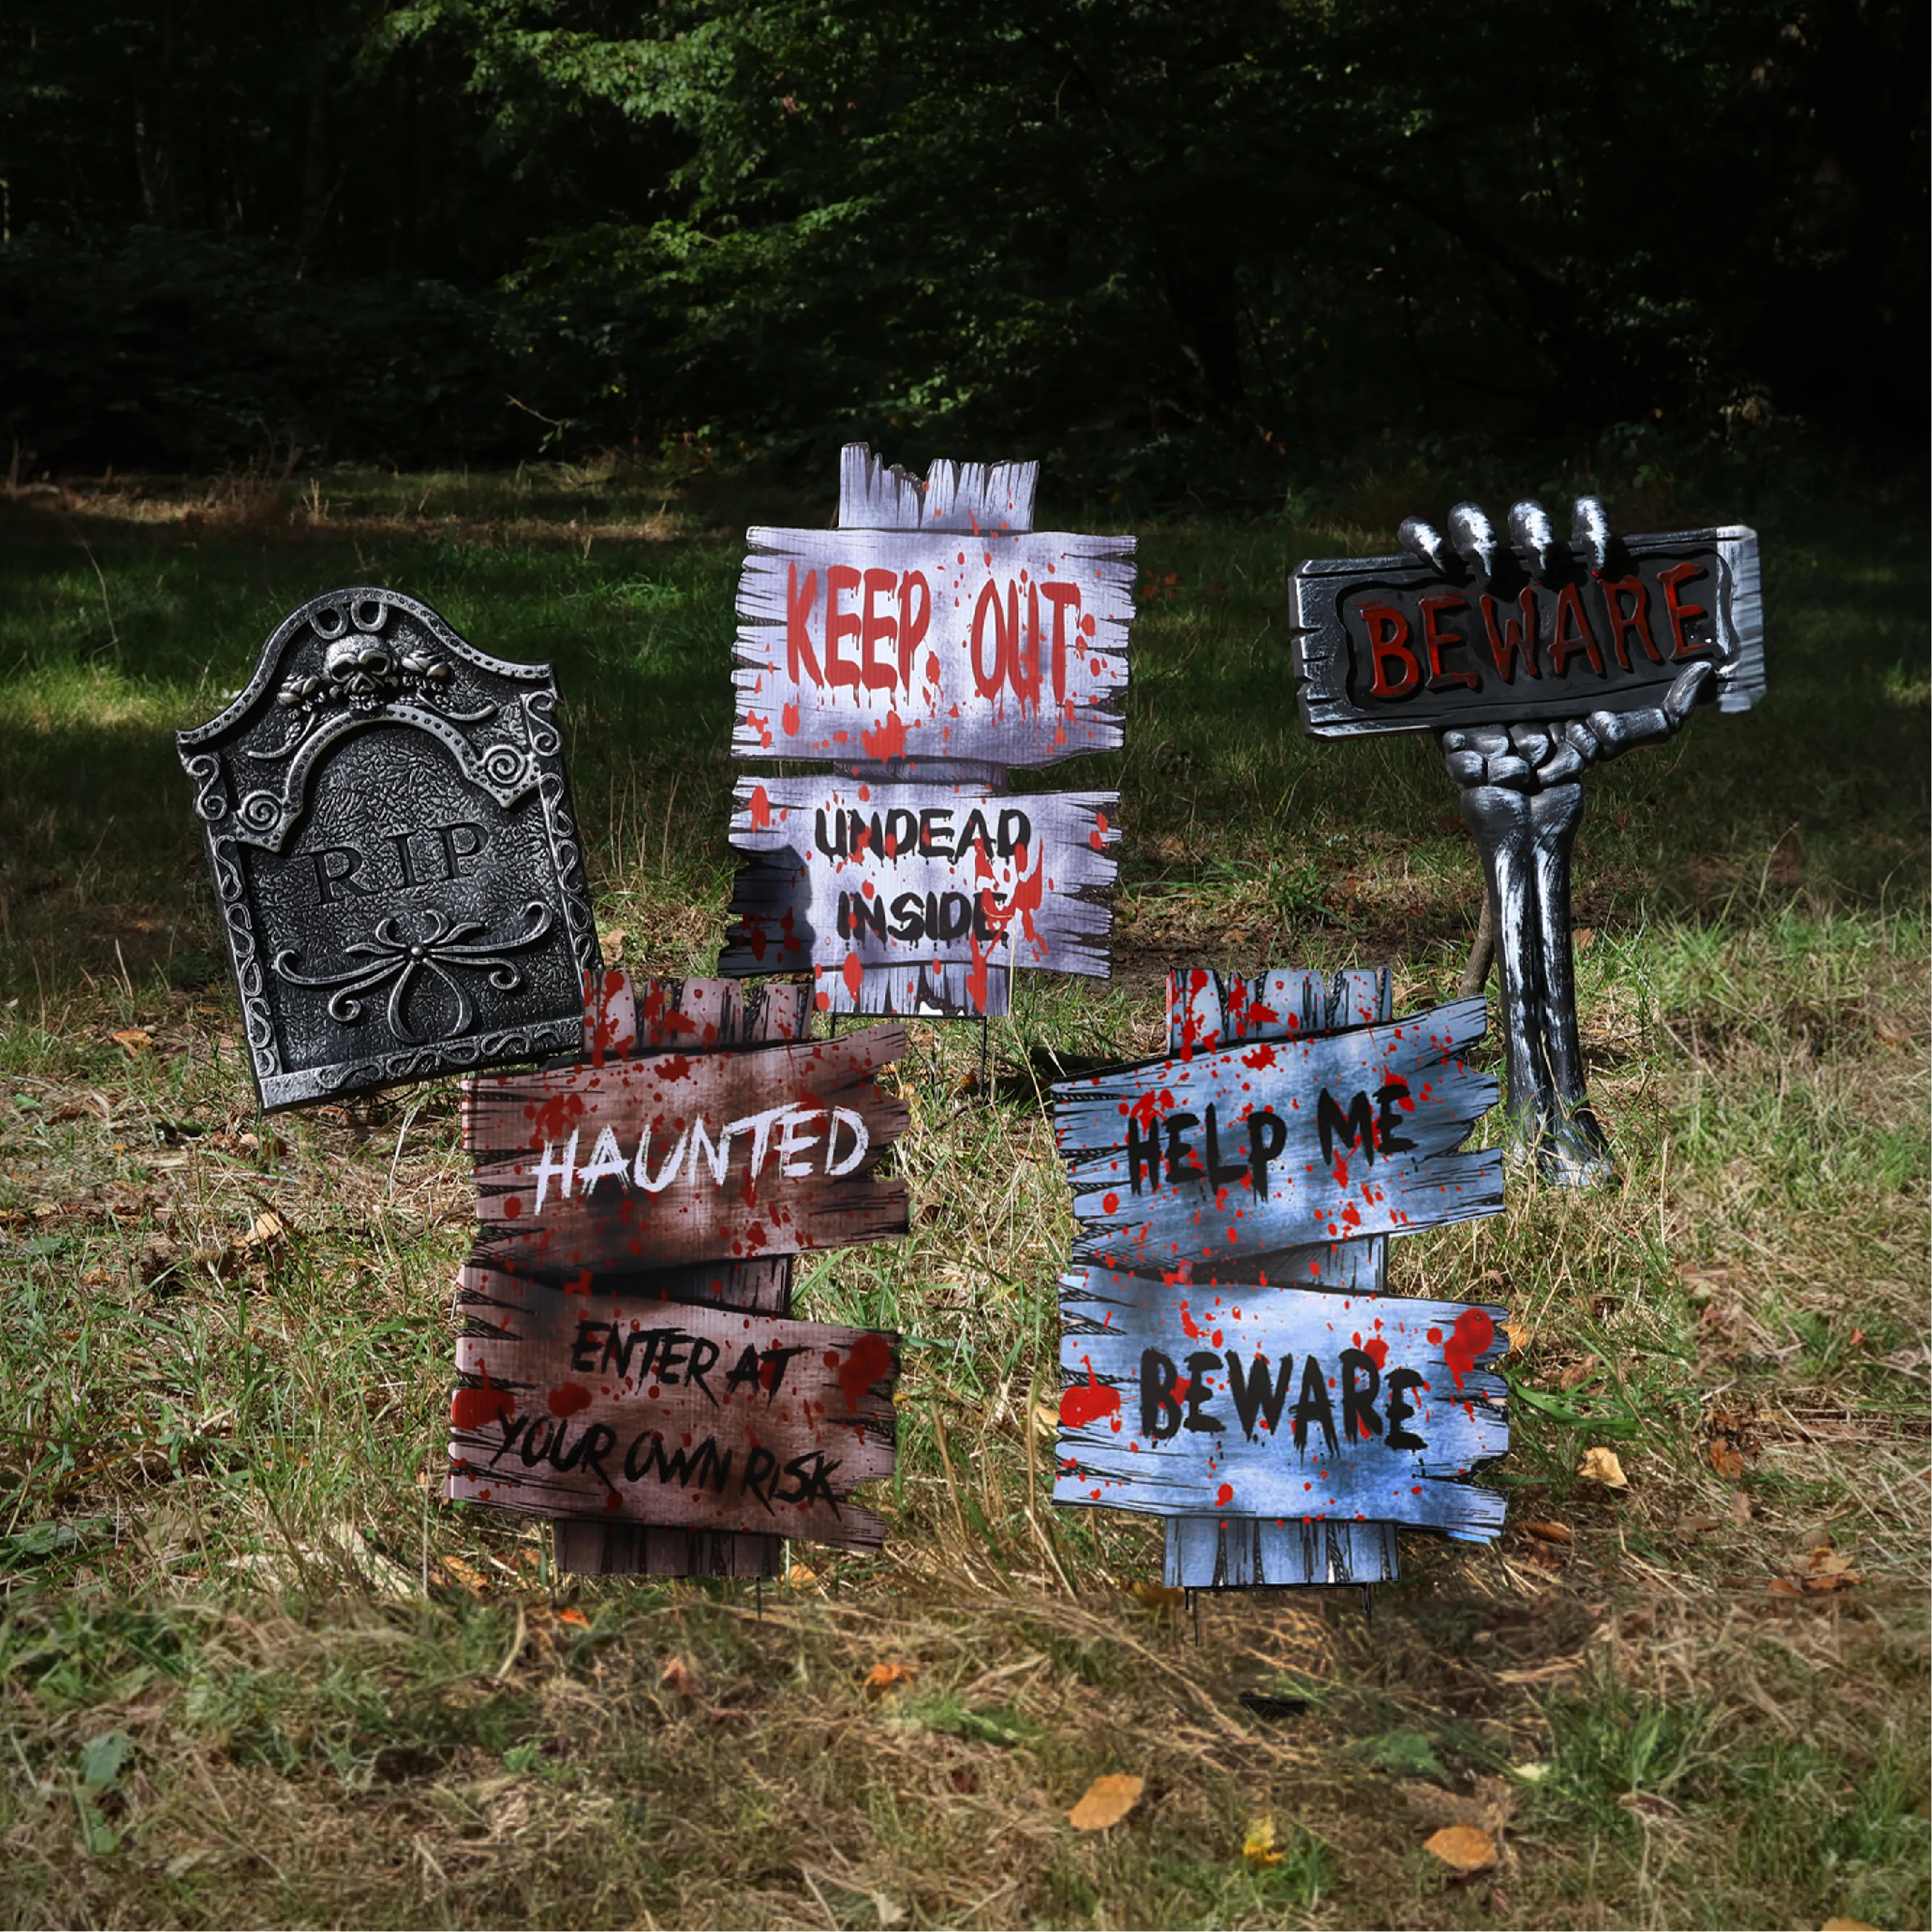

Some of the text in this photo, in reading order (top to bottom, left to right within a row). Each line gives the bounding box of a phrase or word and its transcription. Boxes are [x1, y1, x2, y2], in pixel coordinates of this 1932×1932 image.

[785, 561, 1081, 710] KEEP OUT
[1357, 562, 1713, 696] BEWARE
[301, 822, 491, 907] RIP
[814, 807, 1033, 863] UNDEAD
[837, 890, 1009, 945] INSIDE
[531, 1102, 870, 1216] HAUNTED
[1128, 1083, 1418, 1202] HELP ME
[570, 1319, 815, 1410] ENTER AT
[1139, 1347, 1428, 1464] BEWARE
[489, 1405, 843, 1522] YOUR OWN RISK
